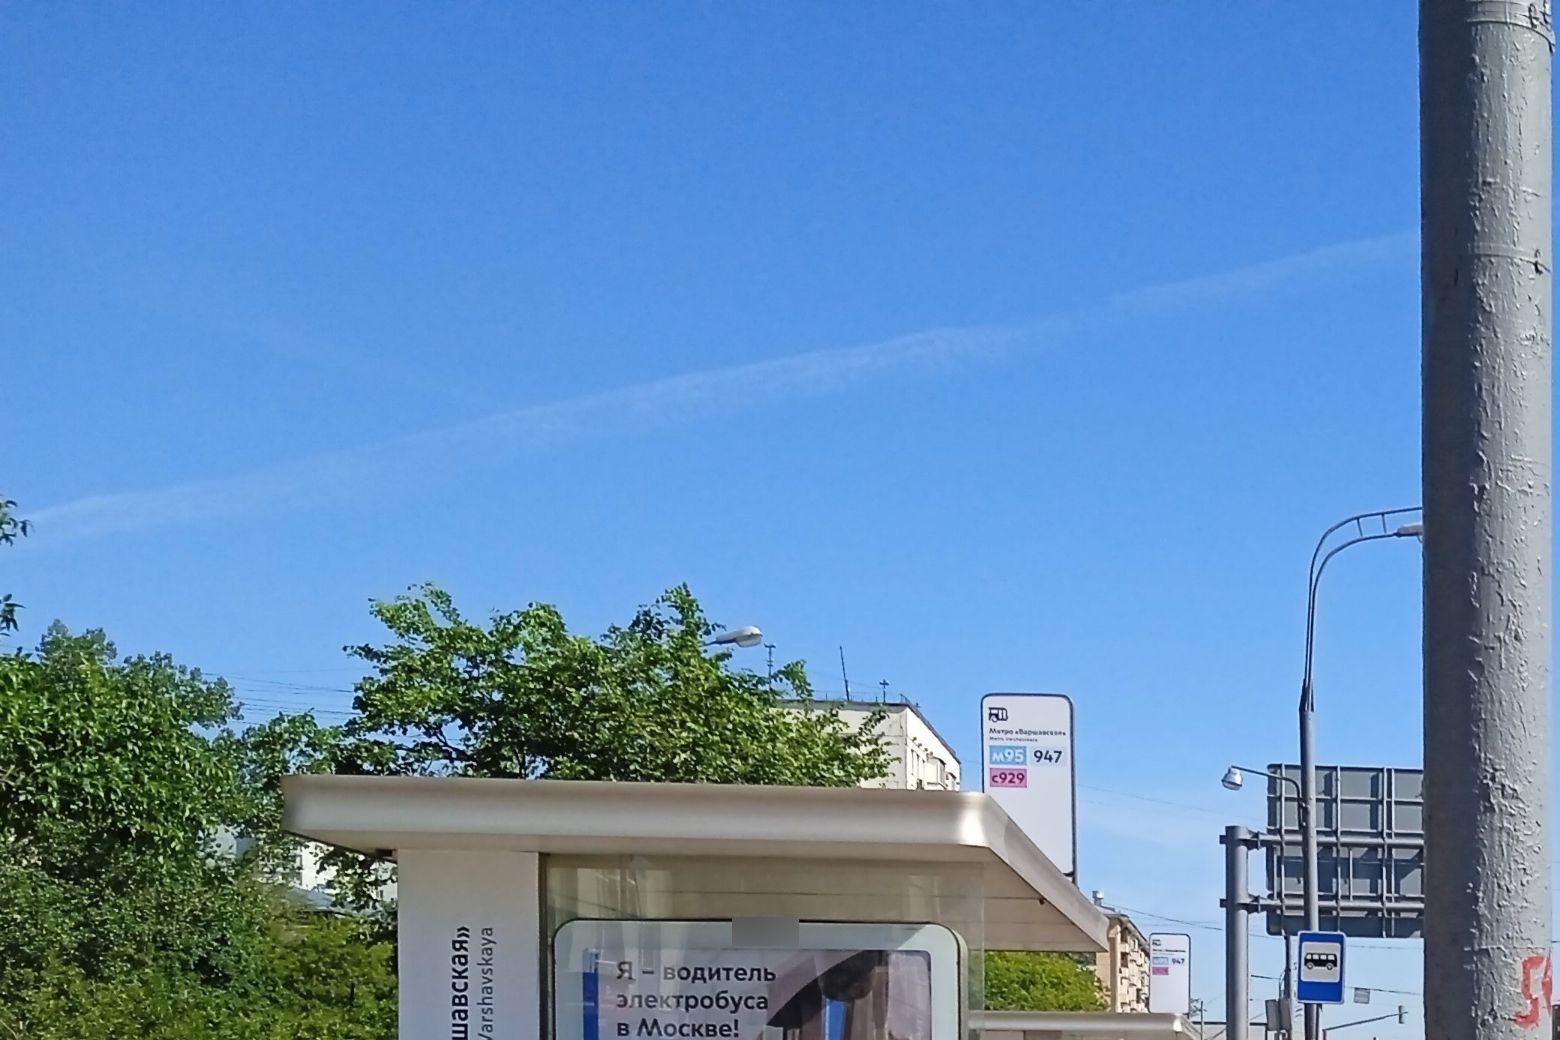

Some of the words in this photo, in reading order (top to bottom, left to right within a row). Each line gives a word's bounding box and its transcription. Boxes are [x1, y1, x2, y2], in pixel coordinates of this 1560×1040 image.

[1034, 750, 1062, 764] 947
[616, 961, 633, 980] Я
[664, 966, 776, 983] водитель
[616, 990, 768, 1014] электробуса
[617, 1022, 629, 1037] в
[637, 1018, 739, 1037] Москве!
